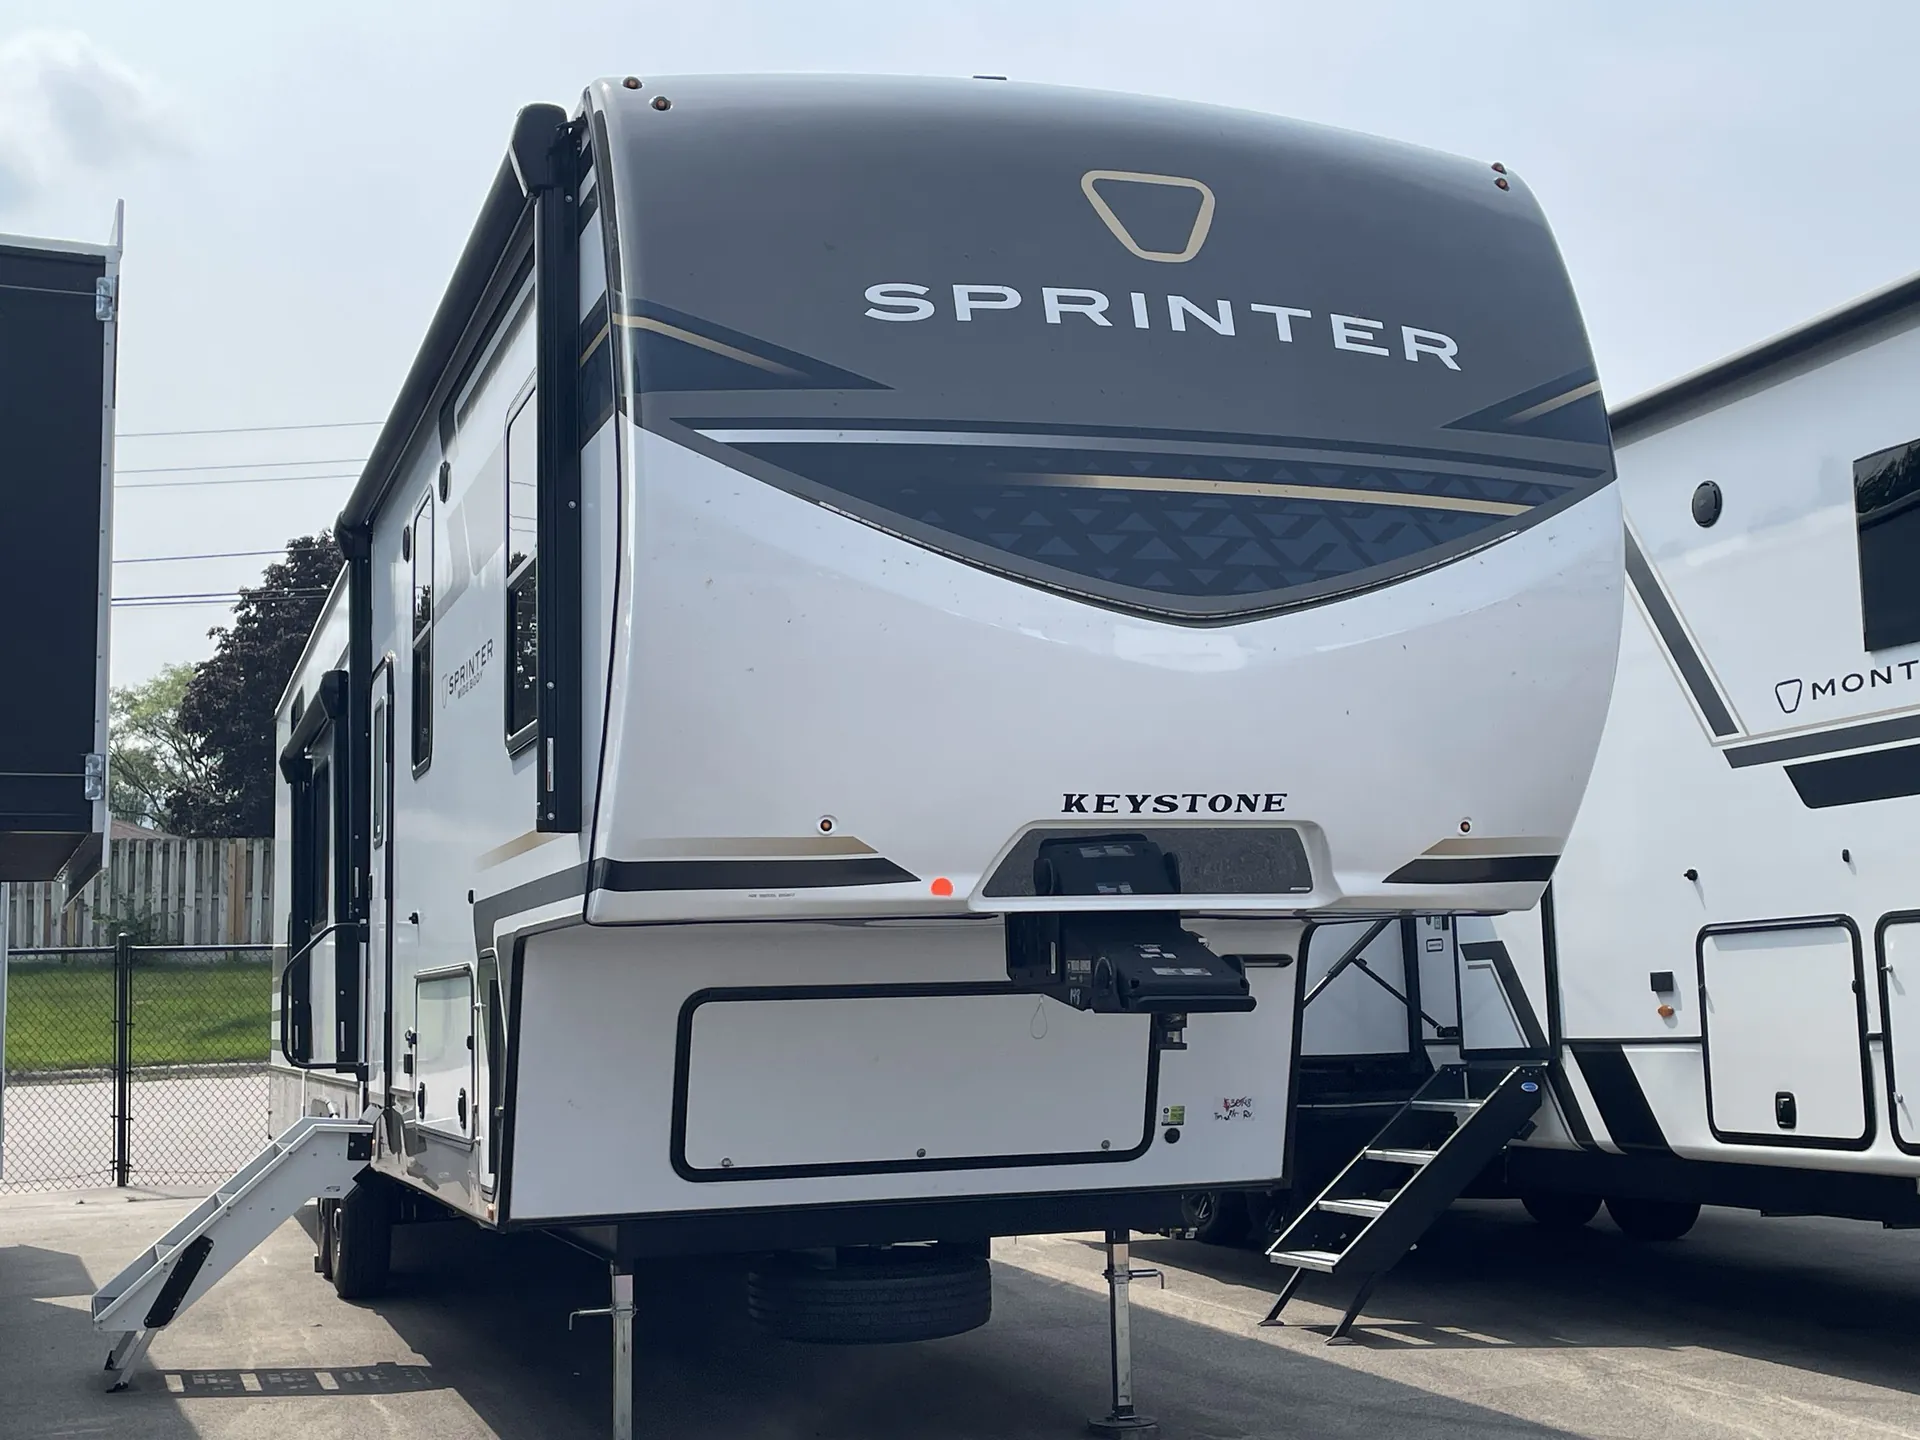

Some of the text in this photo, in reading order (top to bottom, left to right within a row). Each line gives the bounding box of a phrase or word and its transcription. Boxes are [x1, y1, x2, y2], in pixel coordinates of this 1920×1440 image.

[864, 282, 1462, 371] SPRINTER
[449, 638, 494, 695] SPRINTER
[1811, 659, 1920, 701] MONT
[1061, 793, 1288, 814] KEYSTONE
